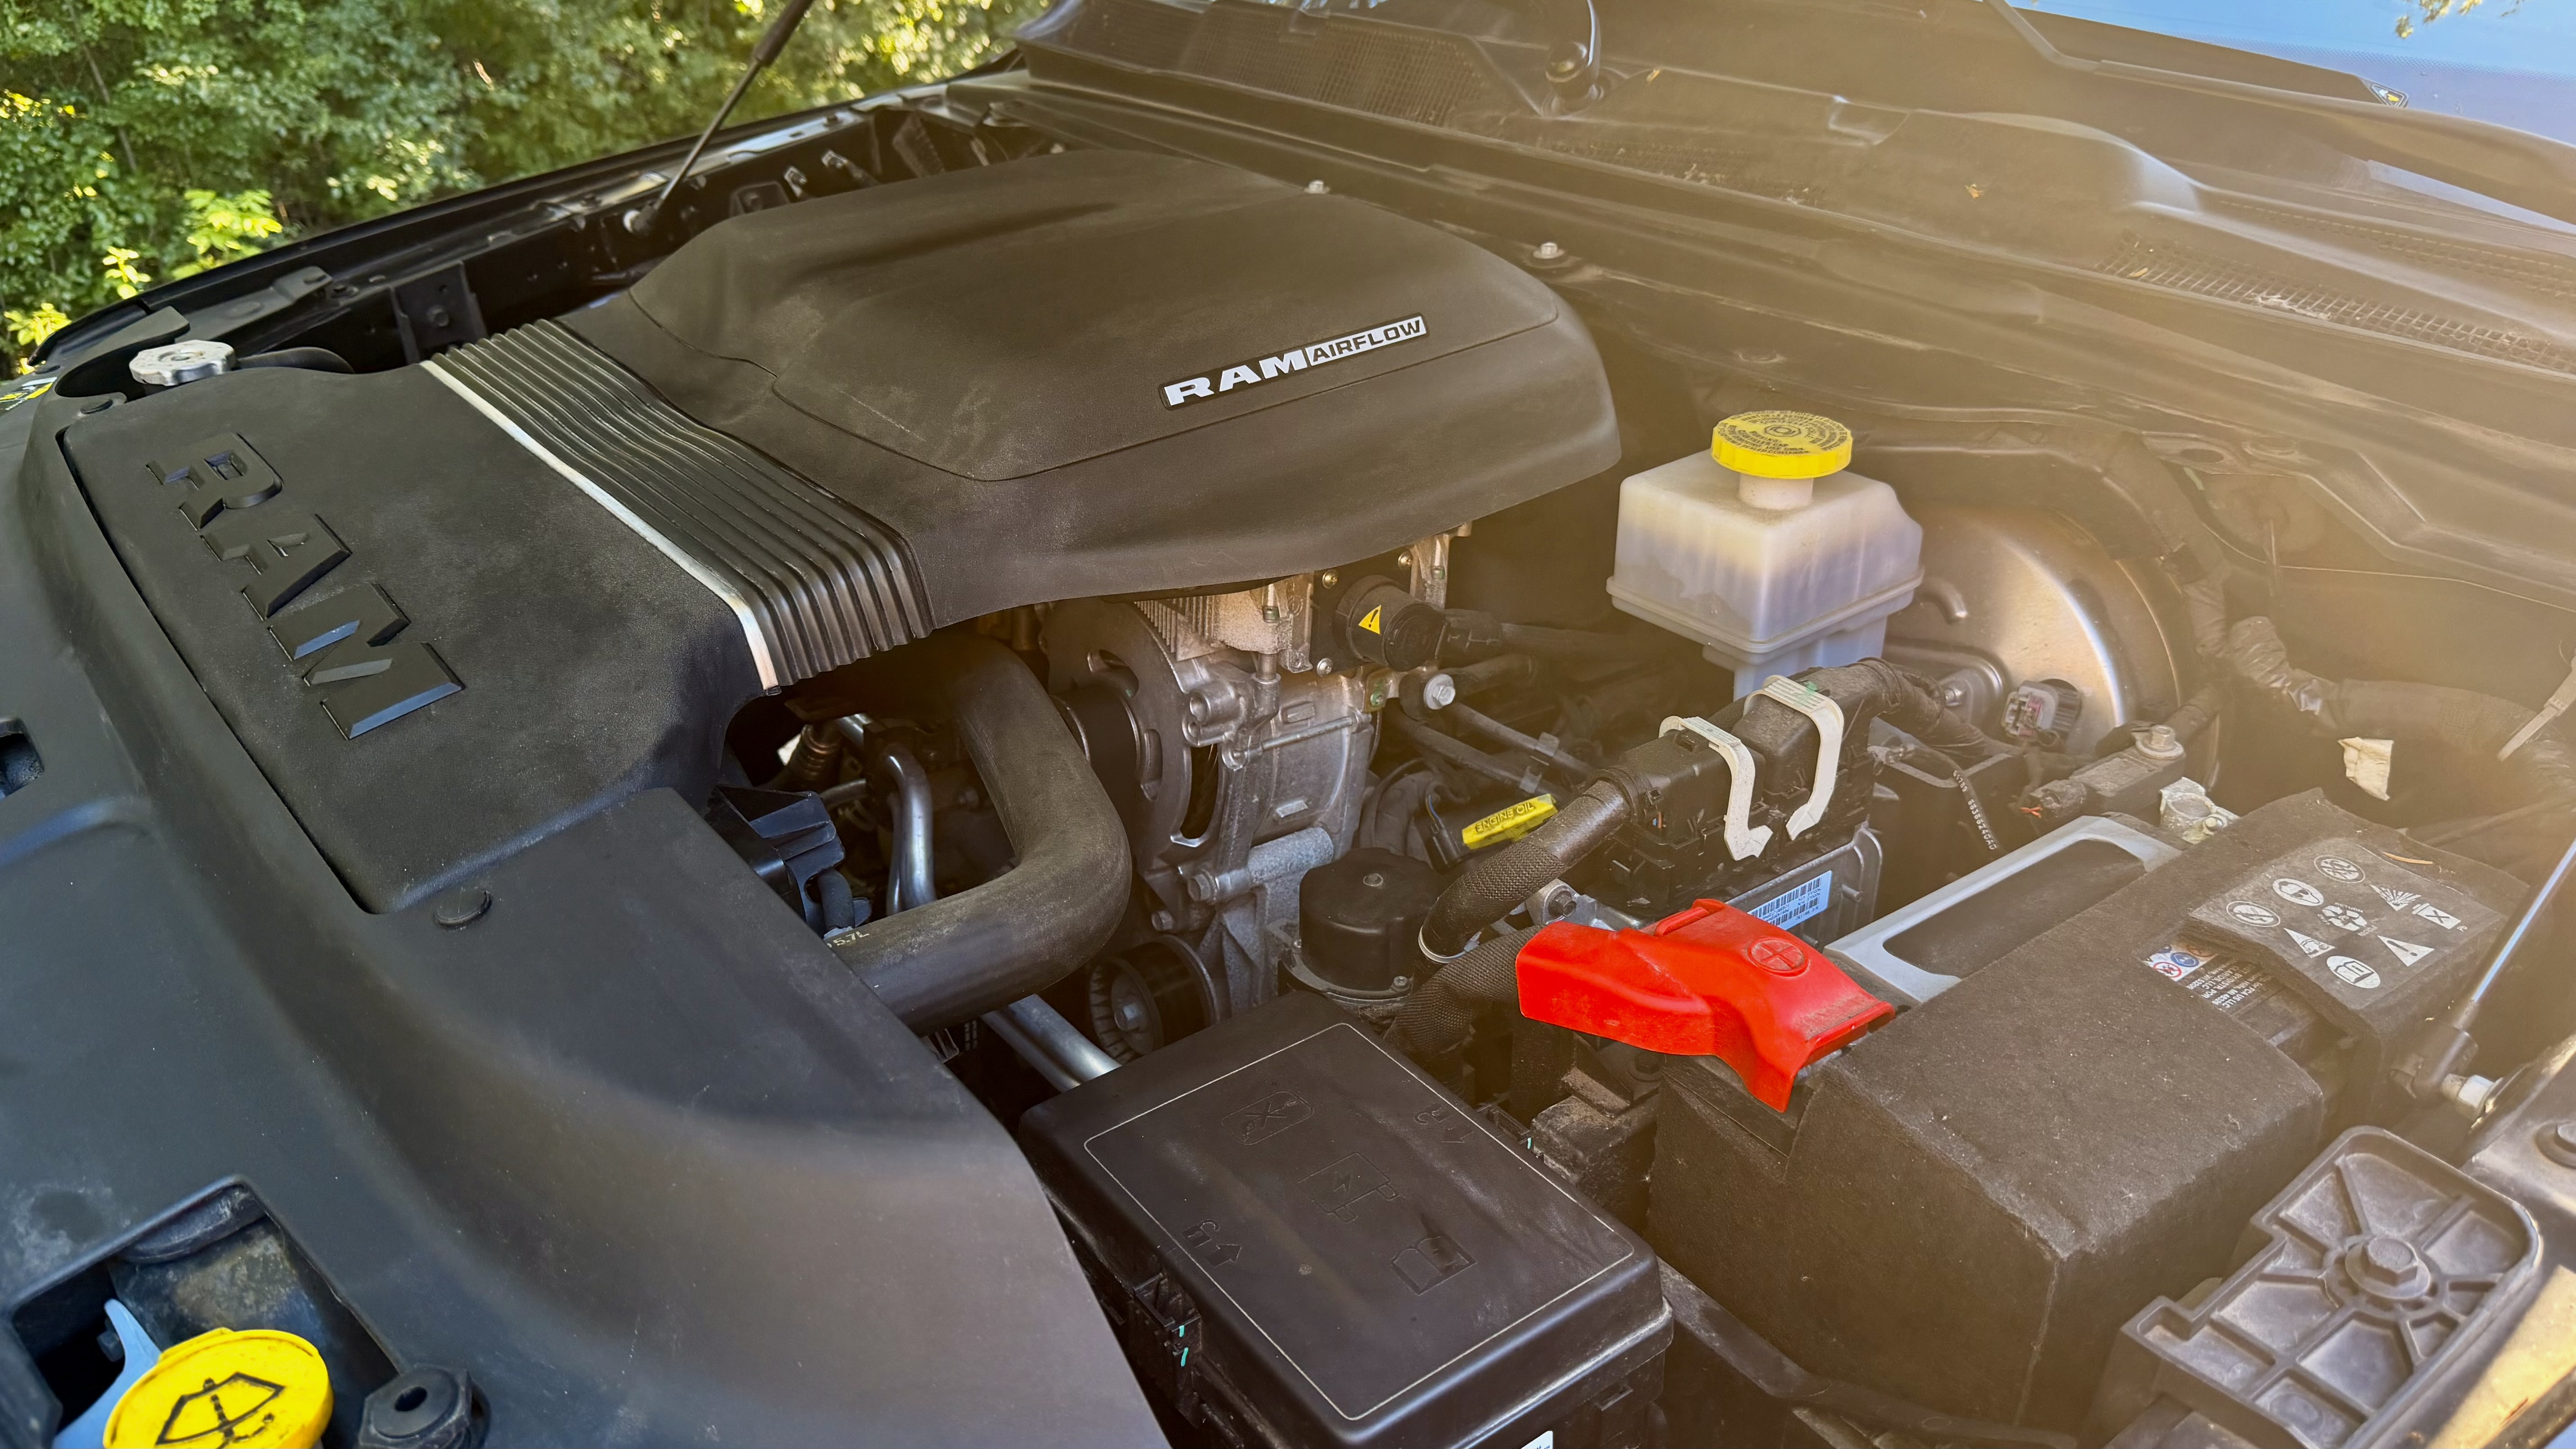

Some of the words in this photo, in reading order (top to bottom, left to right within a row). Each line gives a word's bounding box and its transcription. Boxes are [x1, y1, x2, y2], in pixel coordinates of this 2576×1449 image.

[1164, 350, 1308, 406] RAM
[1313, 319, 1422, 362] AIRFLOW
[145, 431, 466, 740] RAM
[1476, 808, 1514, 833] ENGINE
[1516, 802, 1535, 814] OIL
[833, 931, 870, 946] 5.7L
[2202, 980, 2216, 989] LLC
[2201, 989, 2217, 998] POR
[2242, 987, 2255, 996] FCA
[2222, 998, 2237, 1008] LLC
[2234, 994, 2245, 1002] US
